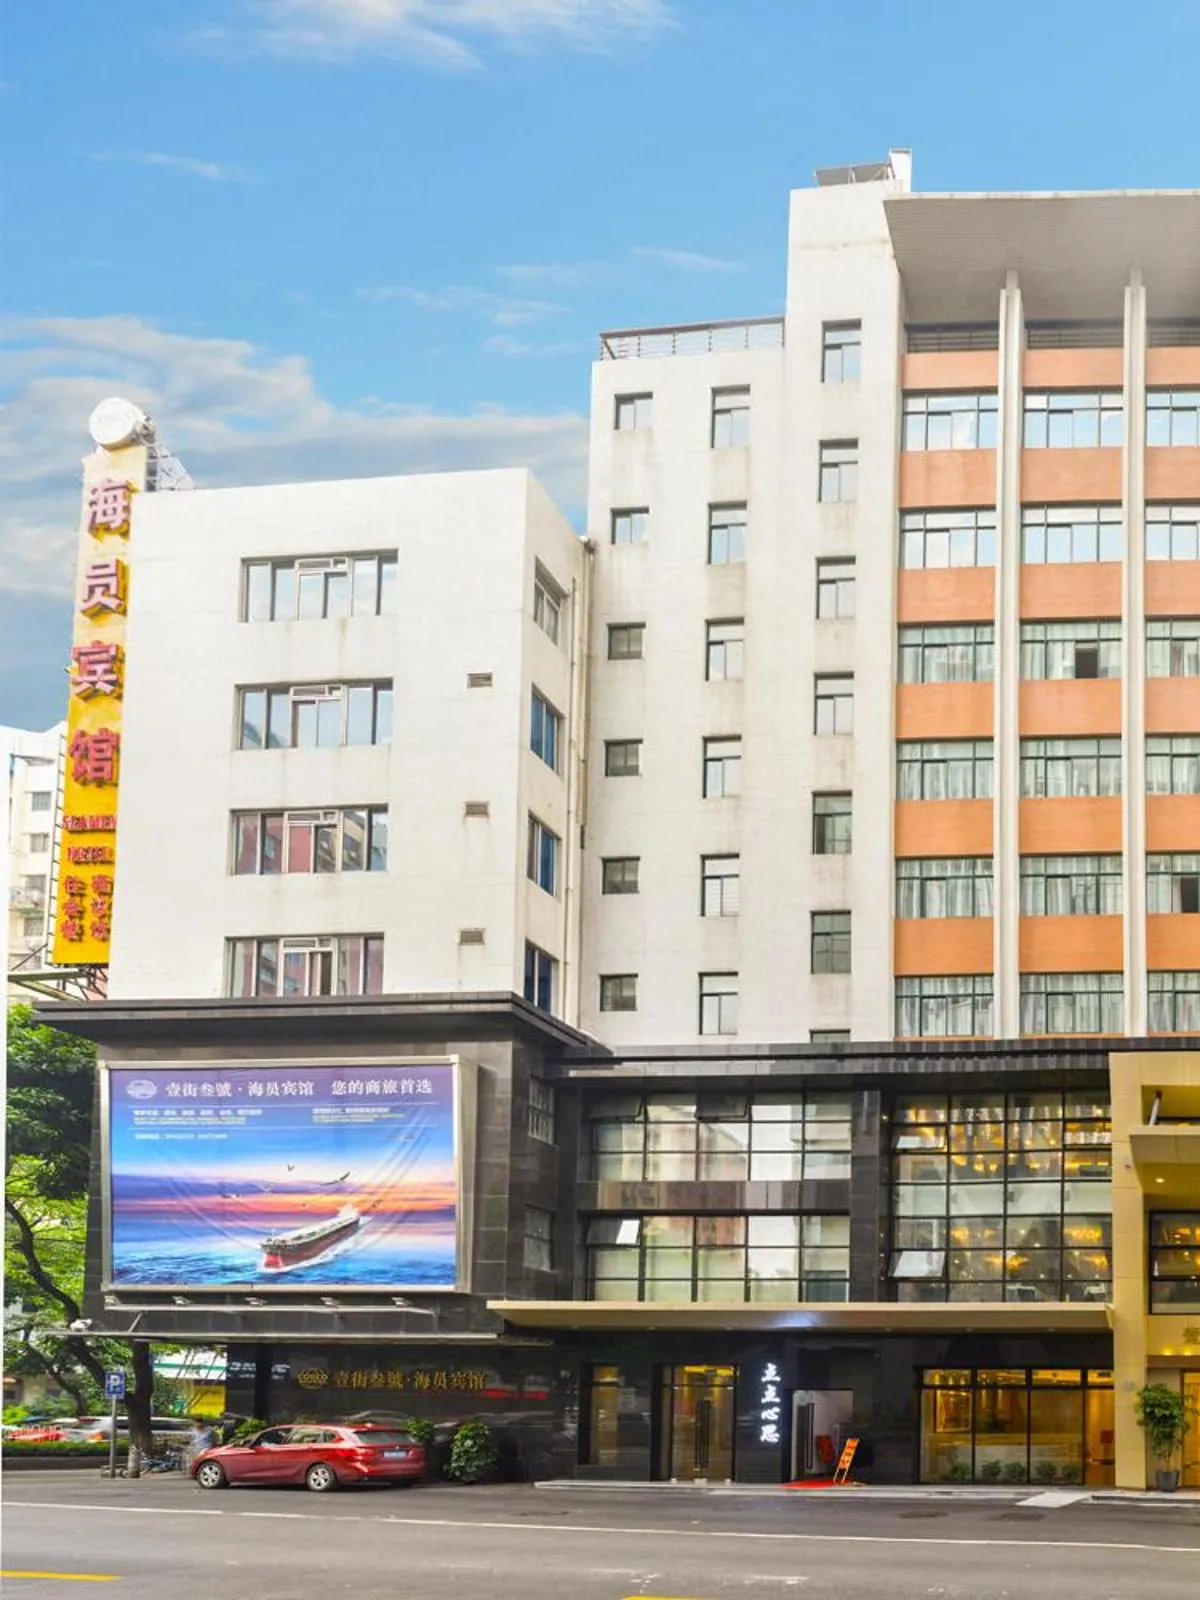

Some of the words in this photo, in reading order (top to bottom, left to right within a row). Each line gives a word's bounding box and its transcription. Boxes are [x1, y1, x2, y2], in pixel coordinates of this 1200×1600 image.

[70, 478, 132, 783] 海员宾馆
[331, 1079, 433, 1096] 您的商旅首选
[110, 1374, 120, 1392] P
